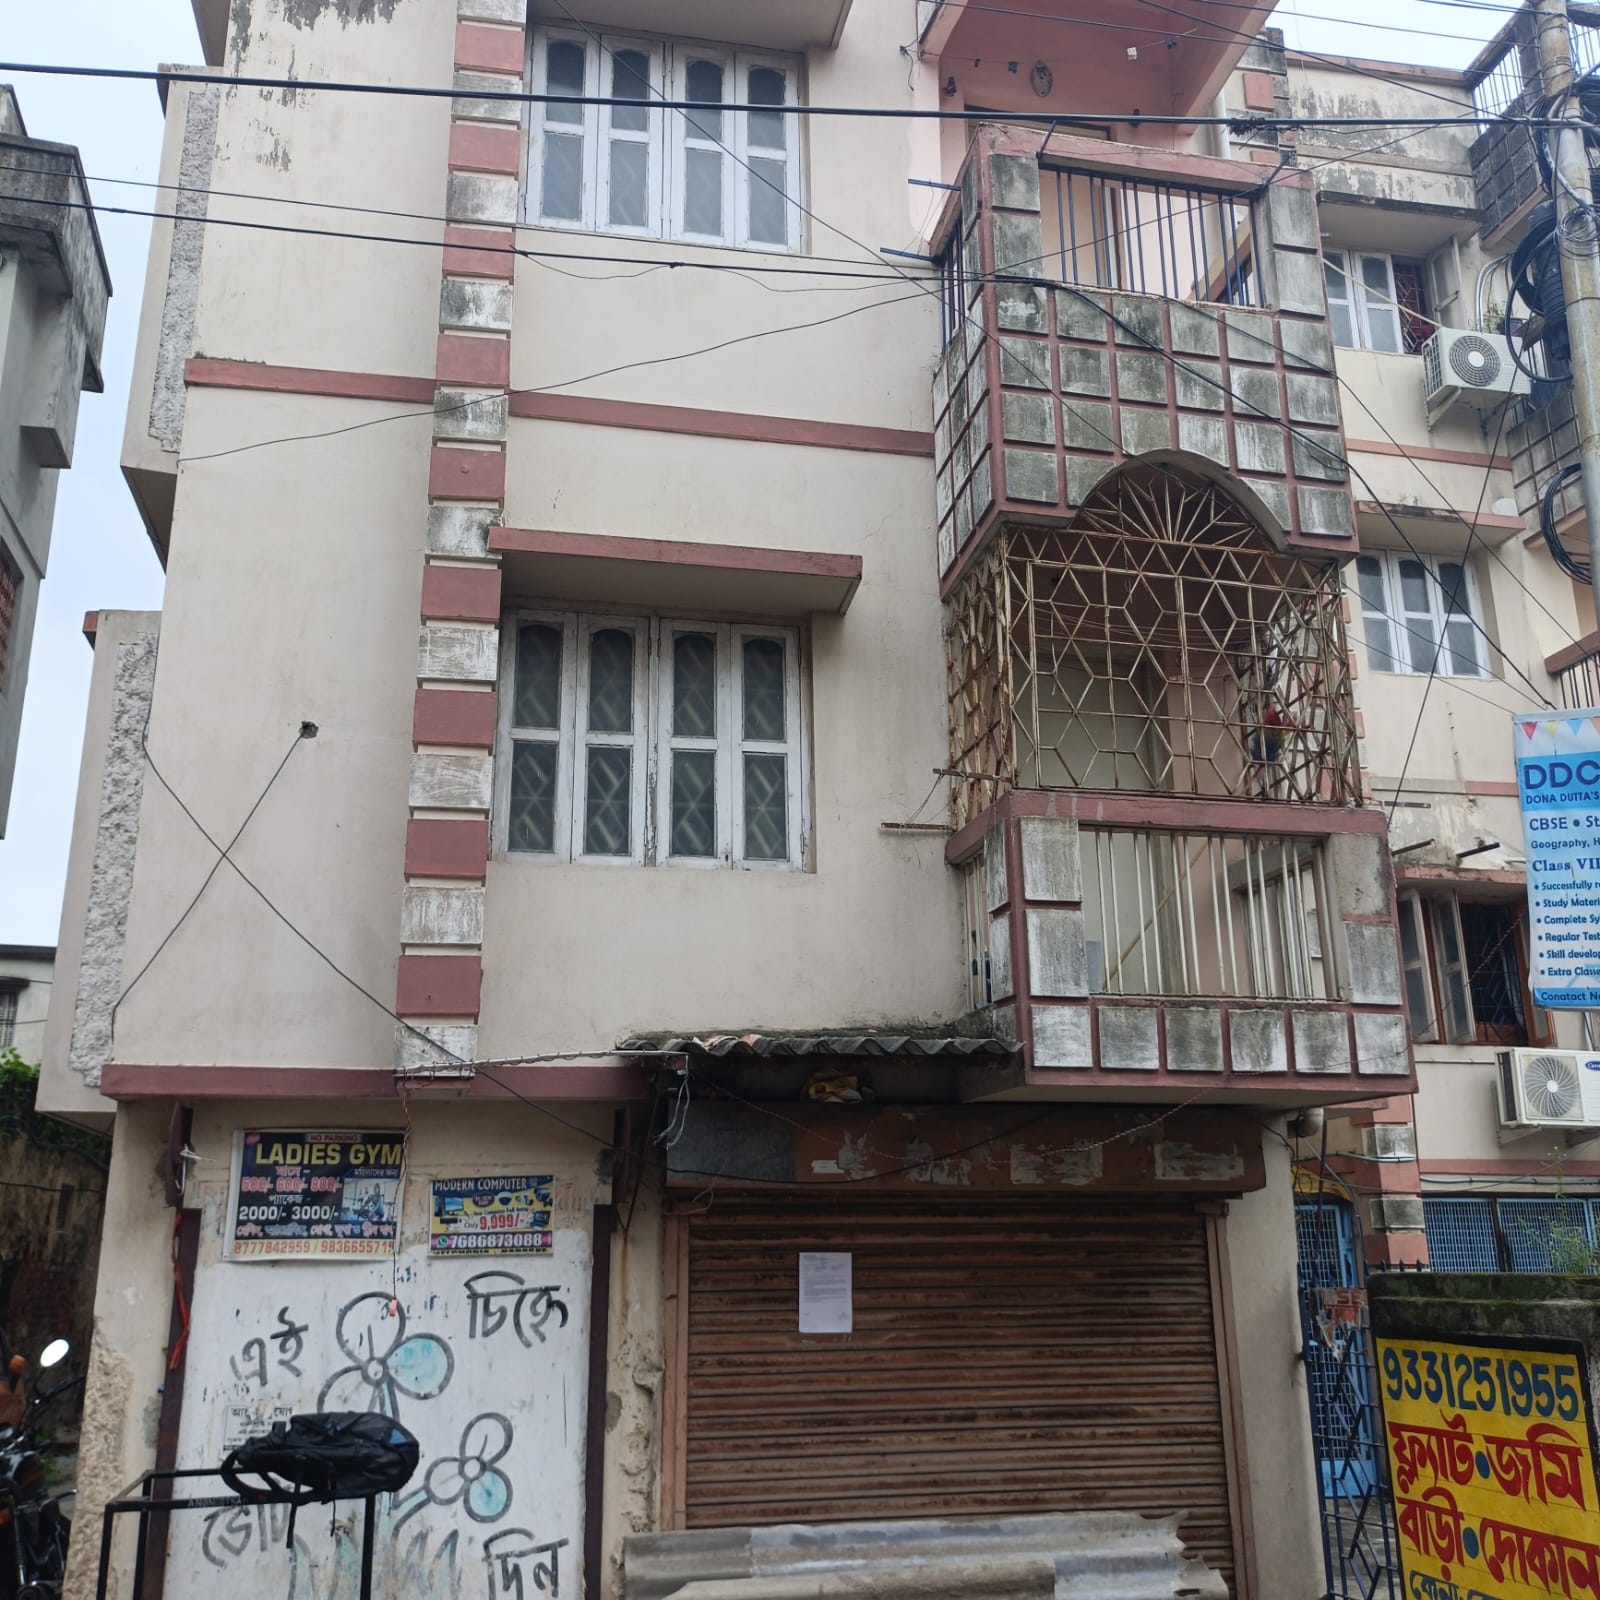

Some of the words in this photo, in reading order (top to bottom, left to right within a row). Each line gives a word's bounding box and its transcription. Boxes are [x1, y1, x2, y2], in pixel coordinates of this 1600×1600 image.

[1526, 794, 1557, 805] DONA
[1560, 791, 1600, 802] DUTTA'S
[1529, 817, 1568, 831] CBSE
[1531, 839, 1590, 850] Geography,
[1532, 860, 1571, 872] Class
[1541, 880, 1593, 891] Successfully
[1543, 898, 1568, 908] Study
[1544, 914, 1587, 925] Complete
[1545, 932, 1580, 942] Regular
[1546, 949, 1565, 959] Skill
[1548, 967, 1572, 976] Extra
[1541, 992, 1586, 1001] Conatact
[255, 1143, 342, 1165] LADIES
[349, 1143, 402, 1165] GYM
[276, 1176, 308, 1193] 600/-
[434, 1180, 475, 1192] MODERN
[477, 1178, 528, 1190] COMPUTER
[239, 1206, 287, 1221] 2000/-
[291, 1206, 339, 1221] 3000/-
[479, 1213, 525, 1231] 9,999/-
[233, 1240, 311, 1255] 8777842959
[450, 1233, 542, 1248] 7686873088
[1383, 1347, 1579, 1421] 9331251955
[1482, 1422, 1584, 1512] জমি
[1479, 1517, 1600, 1600] দোকান
